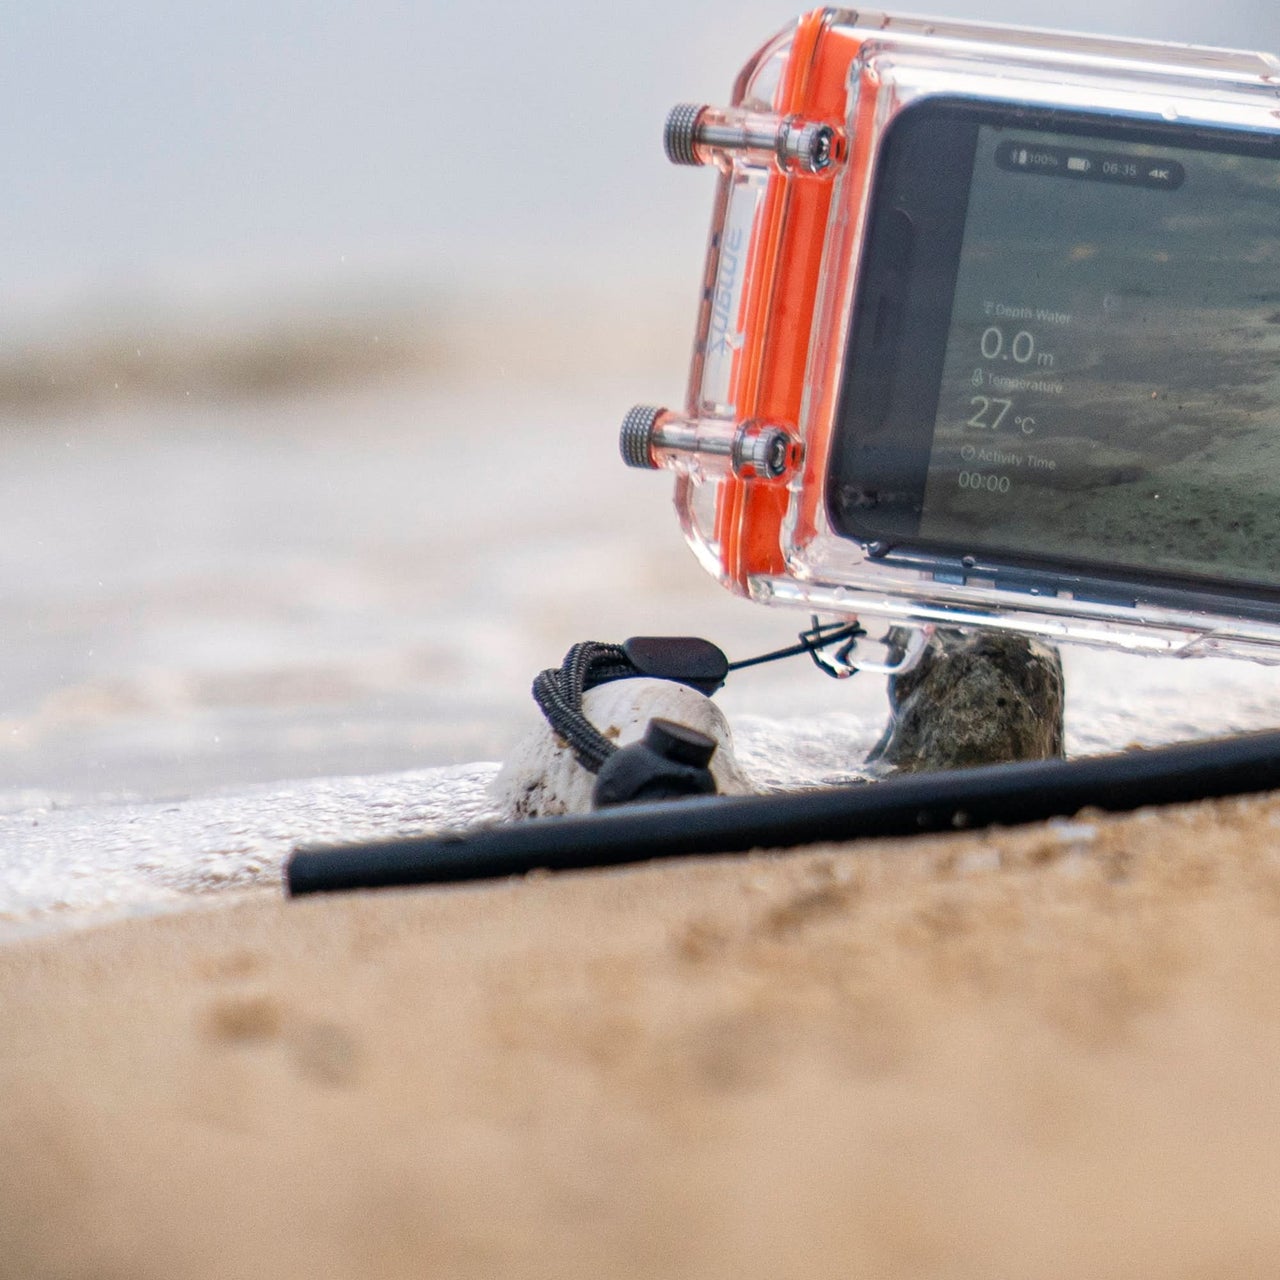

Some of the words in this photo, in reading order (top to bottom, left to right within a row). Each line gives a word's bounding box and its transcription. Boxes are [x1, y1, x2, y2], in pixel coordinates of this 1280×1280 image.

[1149, 169, 1169, 180] 4K
[1037, 308, 1071, 324] Water
[981, 327, 1034, 363] 0.0
[1038, 353, 1054, 366] m
[988, 372, 1064, 394] Temperature
[967, 395, 1012, 429] 27
[978, 449, 1023, 467] Activity
[1027, 455, 1057, 470] Time
[958, 470, 1011, 493] 00:00
